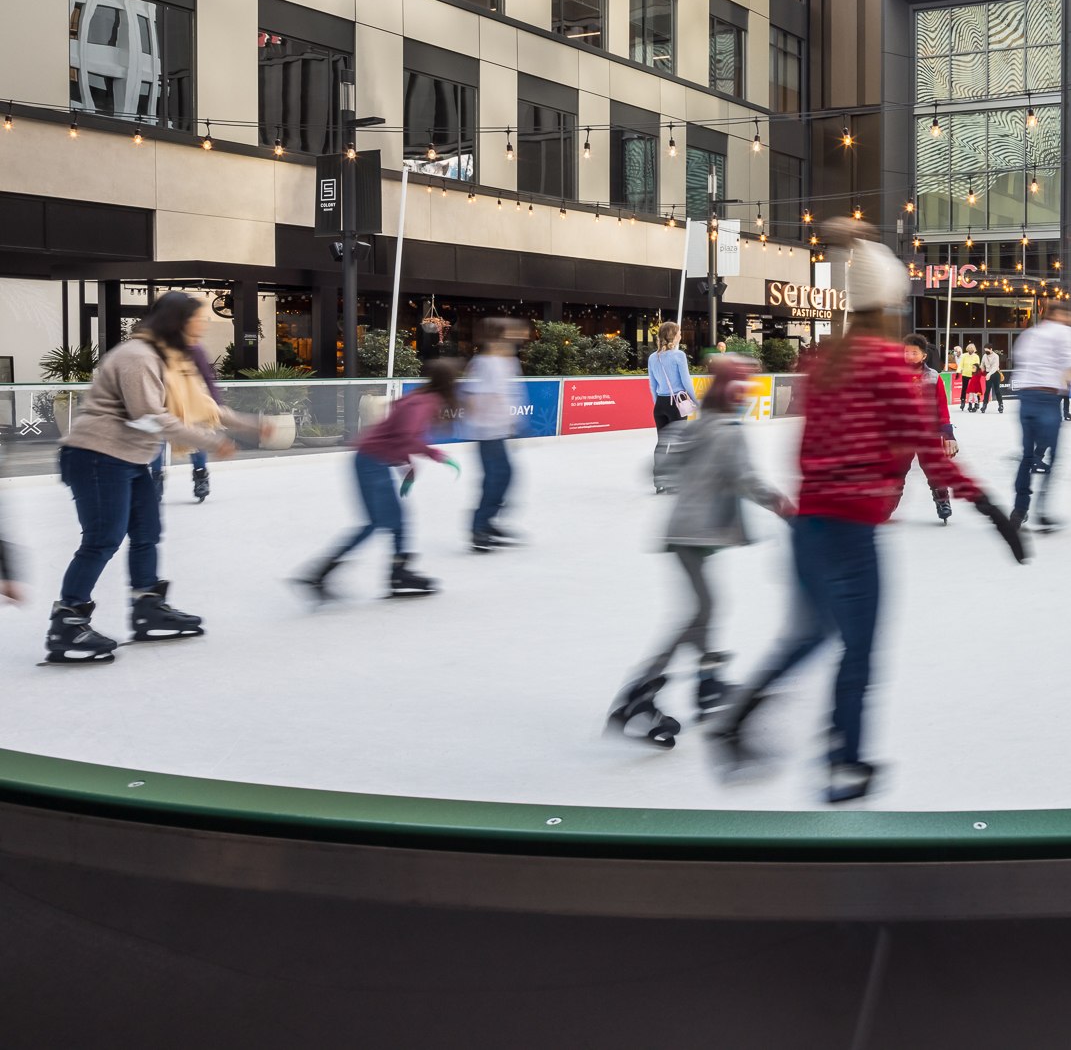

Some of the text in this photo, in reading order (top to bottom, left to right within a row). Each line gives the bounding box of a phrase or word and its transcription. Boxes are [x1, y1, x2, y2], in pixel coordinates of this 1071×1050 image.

[720, 244, 738, 252] plaza
[926, 264, 978, 289] IPIC
[769, 282, 848, 311] serena
[792, 307, 833, 319] PASTIFICIO
[509, 405, 534, 416] DAY!
